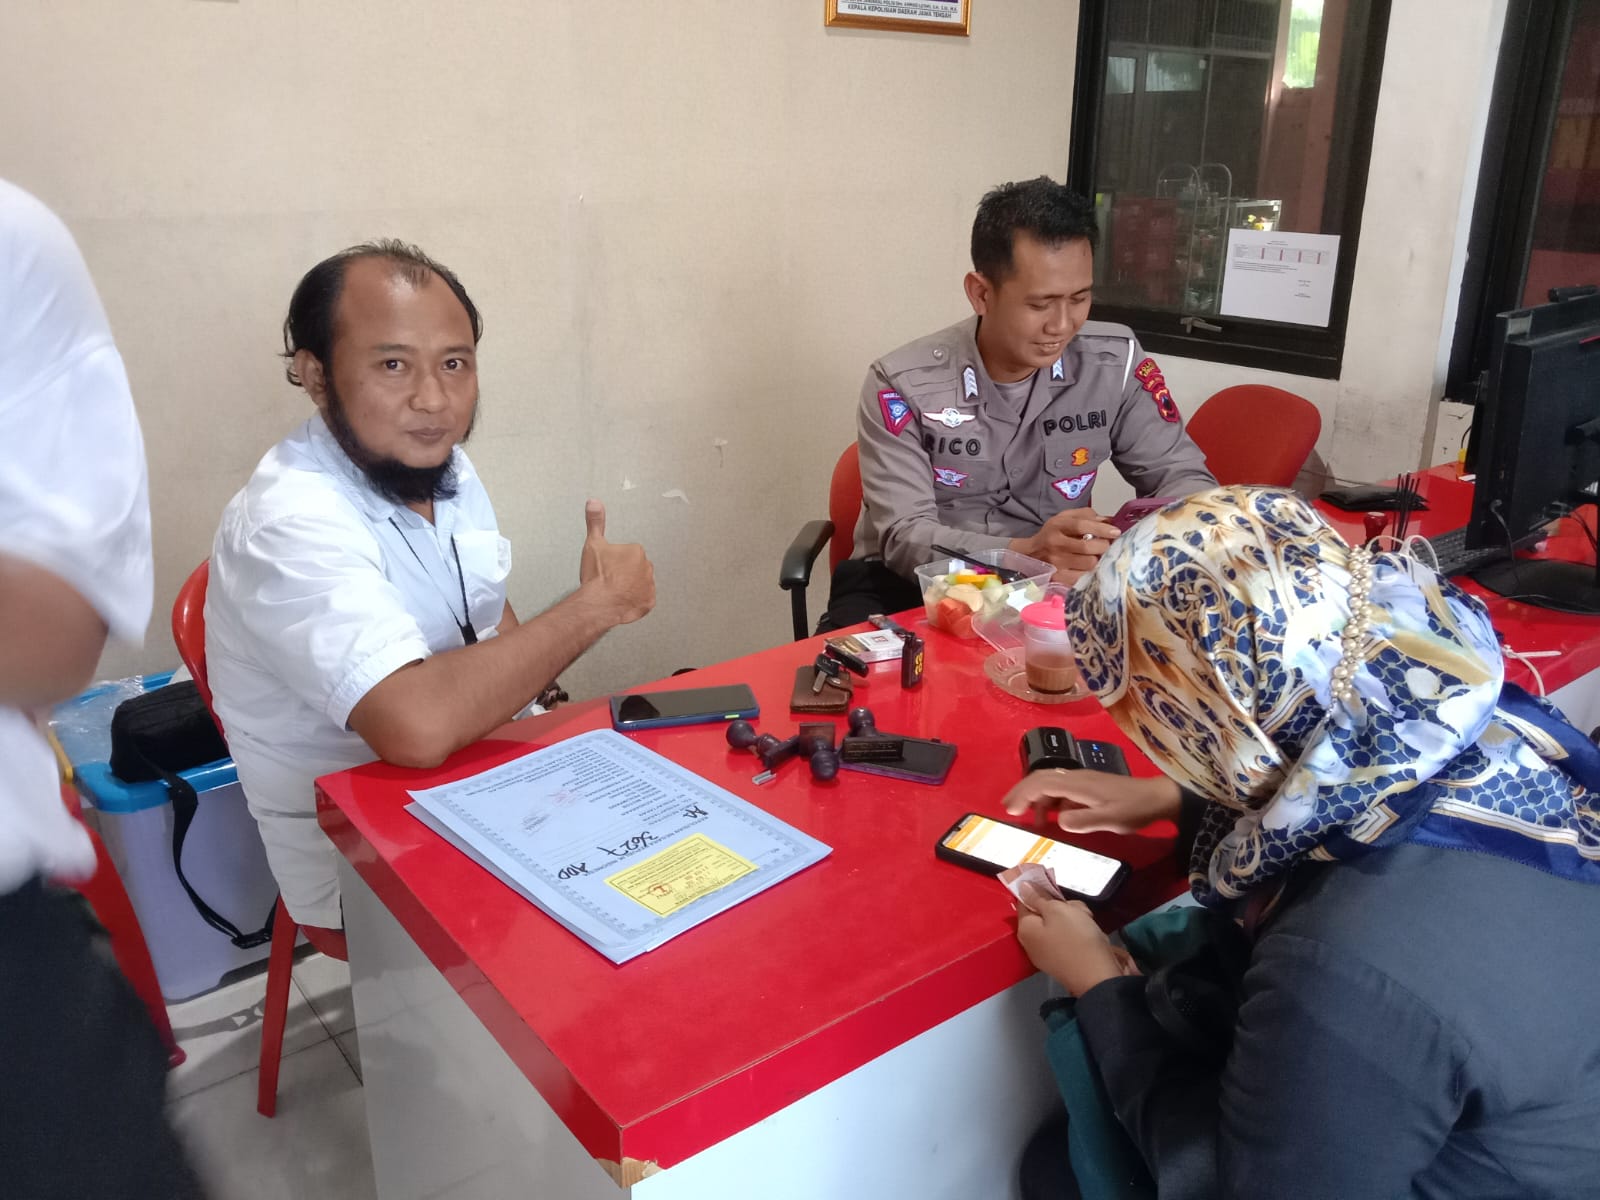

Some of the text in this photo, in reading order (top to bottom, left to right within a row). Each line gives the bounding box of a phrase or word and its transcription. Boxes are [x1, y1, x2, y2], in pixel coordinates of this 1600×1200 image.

[868, 5, 896, 13] KEPOLISIAN
[1043, 409, 1107, 436] POLRI
[923, 432, 982, 456] RICO
[596, 831, 659, 855] 3627
